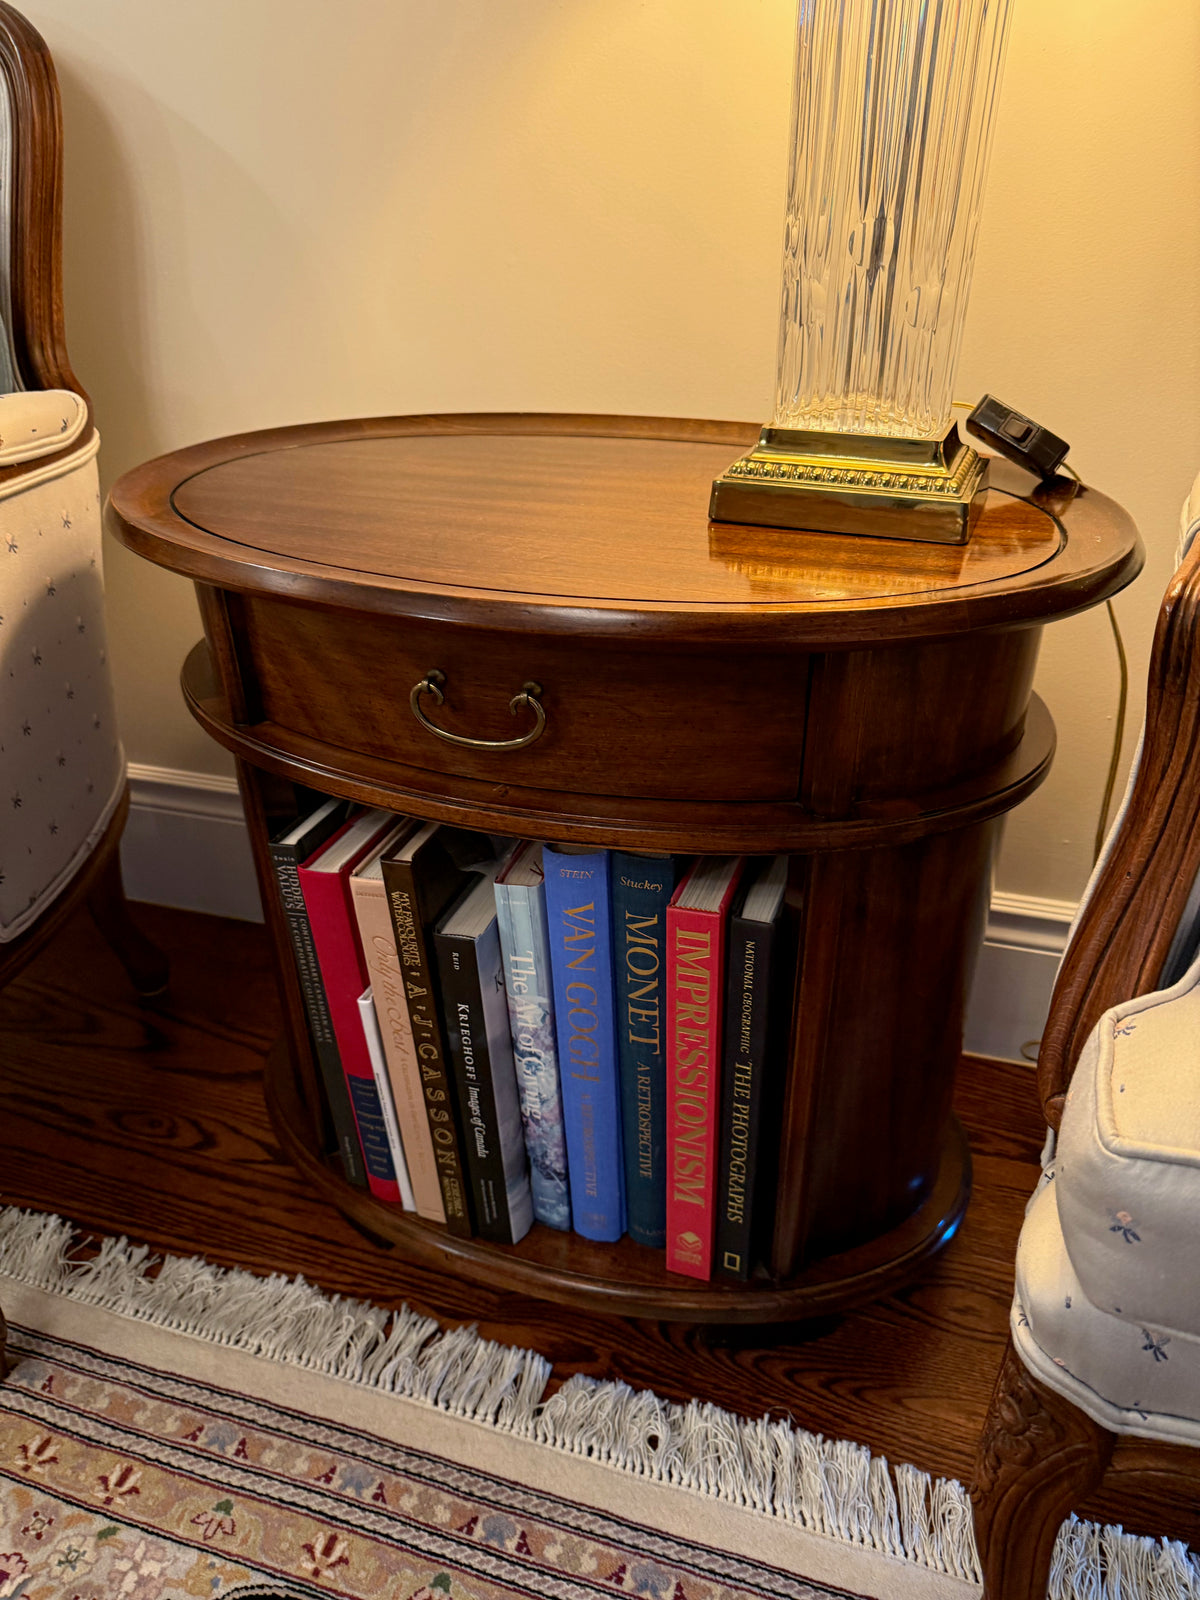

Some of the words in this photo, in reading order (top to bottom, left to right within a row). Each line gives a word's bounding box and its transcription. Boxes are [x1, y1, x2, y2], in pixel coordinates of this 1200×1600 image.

[277, 865, 295, 910] VALUES
[287, 865, 305, 910] HIDDEN
[560, 869, 594, 879] STEIN
[620, 876, 663, 893] Stuckey
[399, 891, 411, 910] MY
[391, 891, 411, 966] WATERCOLOURS
[404, 910, 422, 967] FAVOURITE
[563, 902, 596, 972] VAN
[369, 935, 401, 979] Only
[452, 952, 460, 971] REID
[509, 950, 537, 994] The
[743, 940, 755, 990] NATIONAL
[383, 979, 406, 1004] the
[407, 981, 427, 998] A
[626, 910, 660, 1055] MONET
[387, 1006, 413, 1056] Best
[413, 1014, 432, 1028] J
[514, 996, 540, 1032] Art
[565, 982, 600, 1082] GOGH
[740, 992, 753, 1054] GEOGRAPHIC
[457, 1003, 477, 1080] KRIEGHOFF
[514, 1033, 544, 1062] of
[522, 1055, 545, 1120] Giving
[637, 1061, 650, 1071] A
[675, 926, 711, 1208] IMPRESSIONISM
[733, 1060, 753, 1099] THE
[418, 1042, 457, 1167] CASSON
[467, 1086, 481, 1116] Images
[470, 1115, 486, 1129] of
[475, 1127, 489, 1158] Canada
[637, 1074, 653, 1179] RETROSPECTIVE
[727, 1101, 750, 1224] PHOTOGRAPHS
